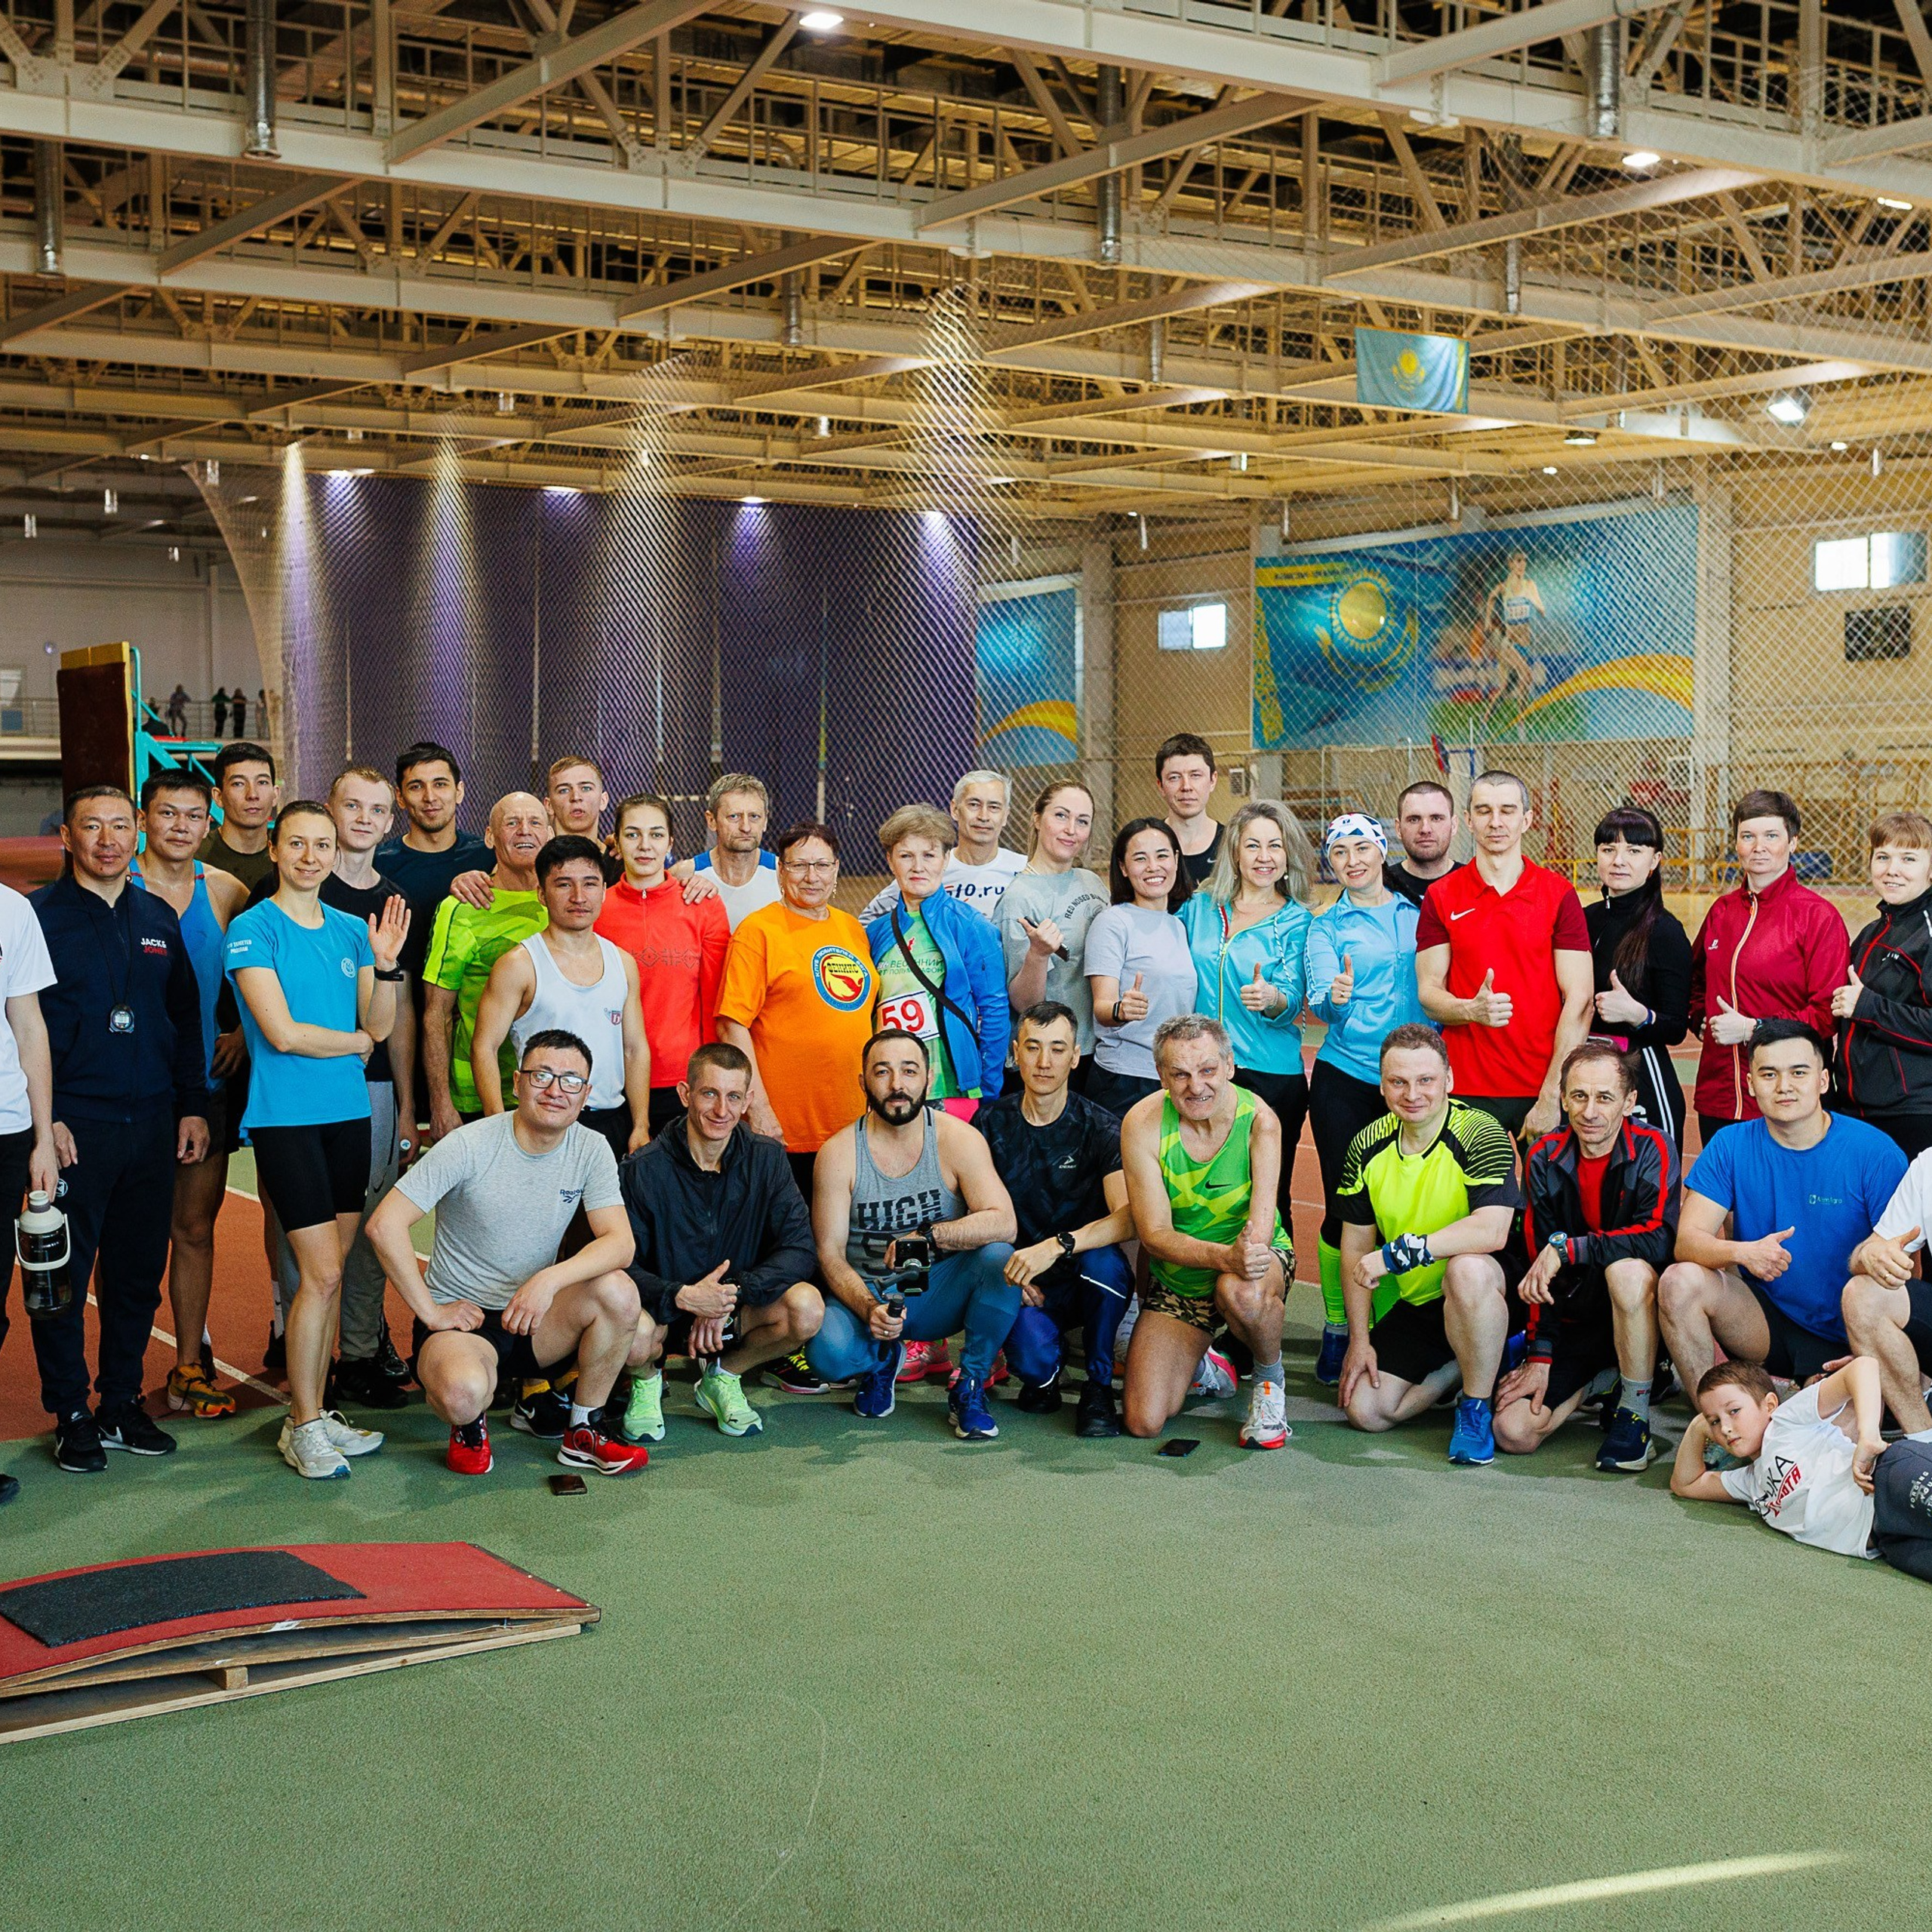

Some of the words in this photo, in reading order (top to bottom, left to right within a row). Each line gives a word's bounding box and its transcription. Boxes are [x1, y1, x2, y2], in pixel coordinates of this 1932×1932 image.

[1064, 905, 1075, 920] RED
[881, 999, 925, 1032] 59
[857, 1189, 941, 1231] HIGH
